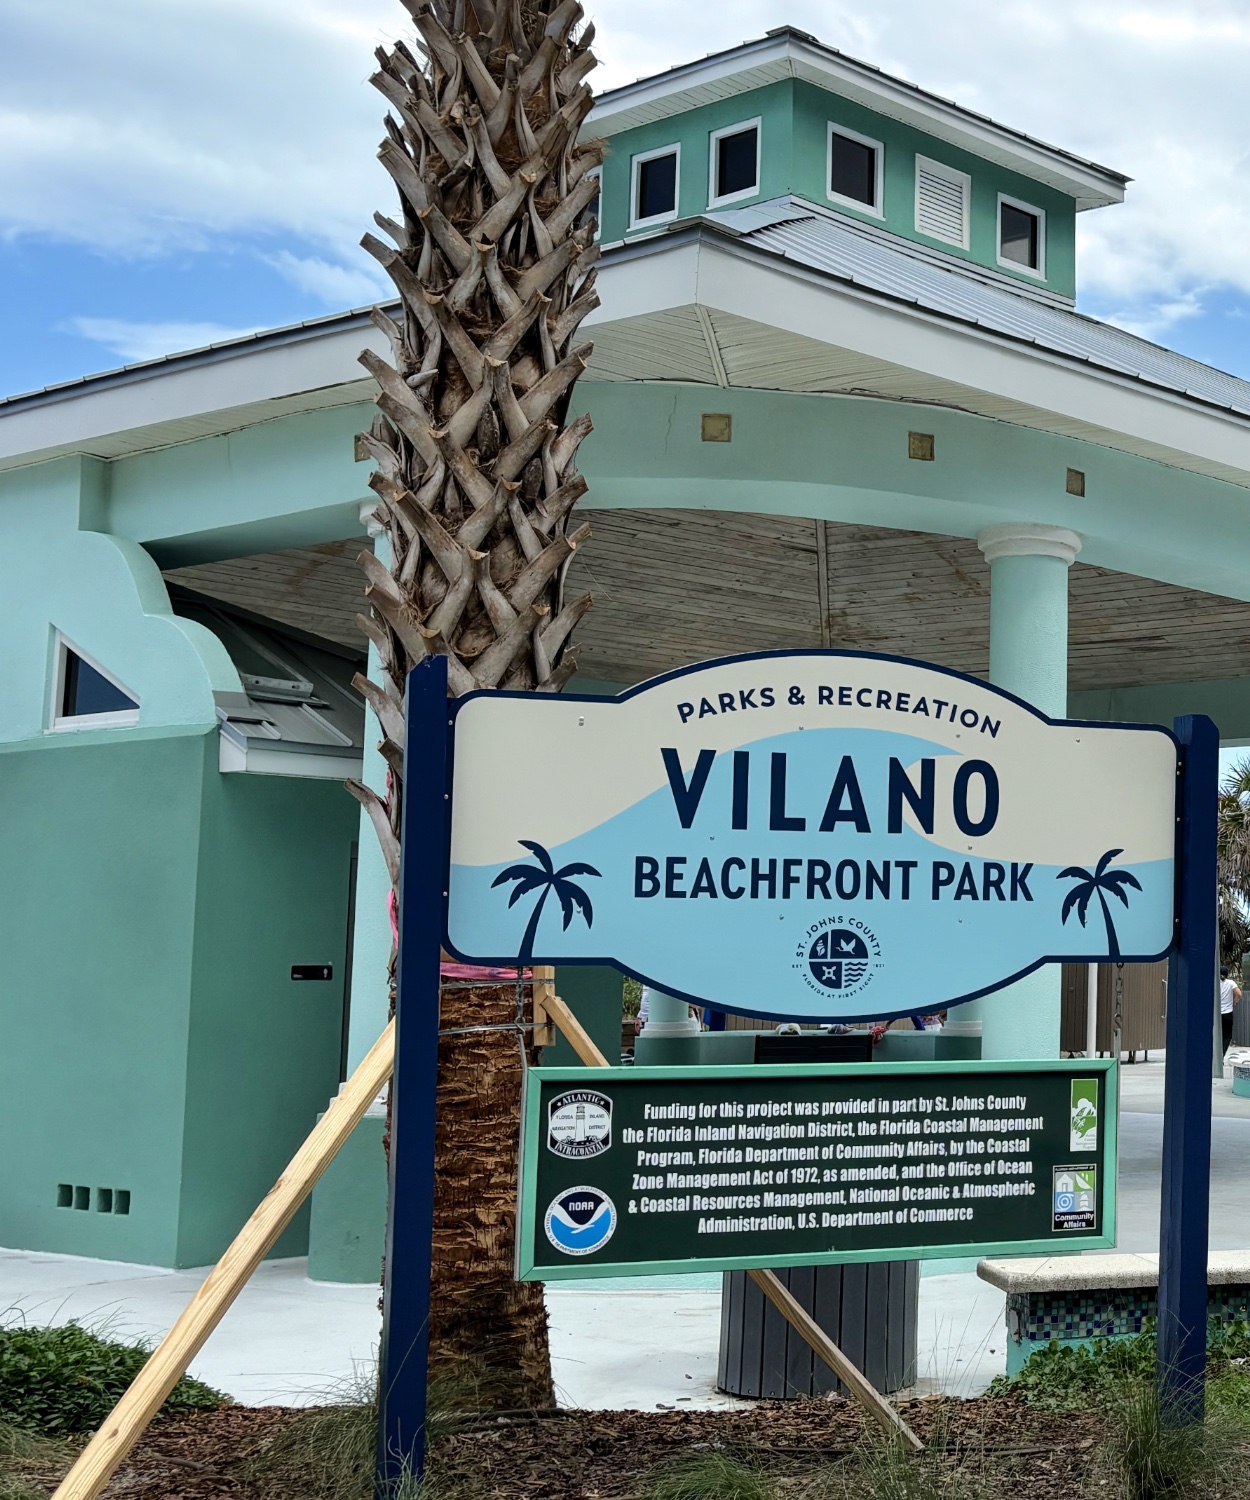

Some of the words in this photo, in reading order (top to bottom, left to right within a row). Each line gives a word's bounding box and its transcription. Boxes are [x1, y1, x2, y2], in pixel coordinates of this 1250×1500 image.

[677, 687, 776, 723] PARKS
[787, 685, 806, 705] &
[818, 685, 1001, 738] RECREATION
[660, 748, 1000, 837] VILANO
[634, 856, 918, 900] BEACHFRONT
[932, 861, 1034, 902] PARK
[796, 941, 808, 958] ST.
[805, 915, 844, 939] JOHNS
[848, 917, 882, 957] COUNTY
[802, 973, 825, 996] FLORIDA
[838, 990, 857, 999] FIRST
[858, 973, 875, 991] SIGHT
[562, 1093, 602, 1106] ATLANTIC
[644, 1103, 696, 1120] Funding
[699, 1102, 717, 1118] for
[719, 1101, 744, 1117] this
[746, 1100, 792, 1118] project
[794, 1102, 819, 1115] was
[822, 1098, 876, 1116] provided
[878, 1098, 890, 1113] in
[892, 1098, 917, 1114] part
[919, 1097, 933, 1113] by
[935, 1096, 949, 1112] St.
[951, 1096, 985, 1111] Johns
[987, 1095, 1027, 1110] County
[622, 1127, 644, 1143] the
[647, 1126, 692, 1143] Florida
[695, 1124, 736, 1141] Inland
[738, 1123, 805, 1141] Navigation
[808, 1121, 855, 1137] District,
[857, 1120, 877, 1136] the
[879, 1119, 921, 1135] Florida
[923, 1118, 967, 1134] Coastal
[969, 1116, 1044, 1133] Management
[554, 1141, 606, 1156] INTRACOASTAL
[637, 1150, 696, 1167] Program,
[698, 1147, 743, 1164] Florida
[745, 1146, 819, 1164] Department
[821, 1144, 834, 1160] of
[836, 1142, 905, 1159] Community
[906, 1140, 948, 1156] Affairs,
[950, 1140, 964, 1156] by
[966, 1139, 985, 1154] the
[987, 1137, 1030, 1153] Coastal
[632, 1174, 664, 1190] Zone
[666, 1171, 751, 1189] Management
[753, 1169, 774, 1185] Act
[776, 1168, 789, 1184] of
[790, 1167, 821, 1184] 1972,
[823, 1169, 838, 1182] as
[840, 1164, 899, 1181] amended,
[901, 1163, 924, 1179] and
[926, 1163, 945, 1178] the
[948, 1161, 982, 1177] Office
[983, 1160, 996, 1175] of
[997, 1159, 1033, 1175] Ocean
[628, 1200, 638, 1214] &
[640, 1195, 690, 1213] Coastal
[693, 1195, 761, 1211] Resources
[763, 1190, 847, 1208] Management,
[849, 1186, 900, 1203] National
[902, 1184, 950, 1201] Oceanic
[952, 1186, 961, 1199] &
[962, 1180, 1035, 1198] Atmospheric
[698, 1214, 795, 1233] Administration,
[798, 1212, 819, 1229] U.S.
[822, 1210, 894, 1228] Department
[895, 1208, 908, 1224] of
[910, 1207, 973, 1223] Commerce
[1055, 1212, 1094, 1221] Community
[1063, 1220, 1087, 1229] Affairs
